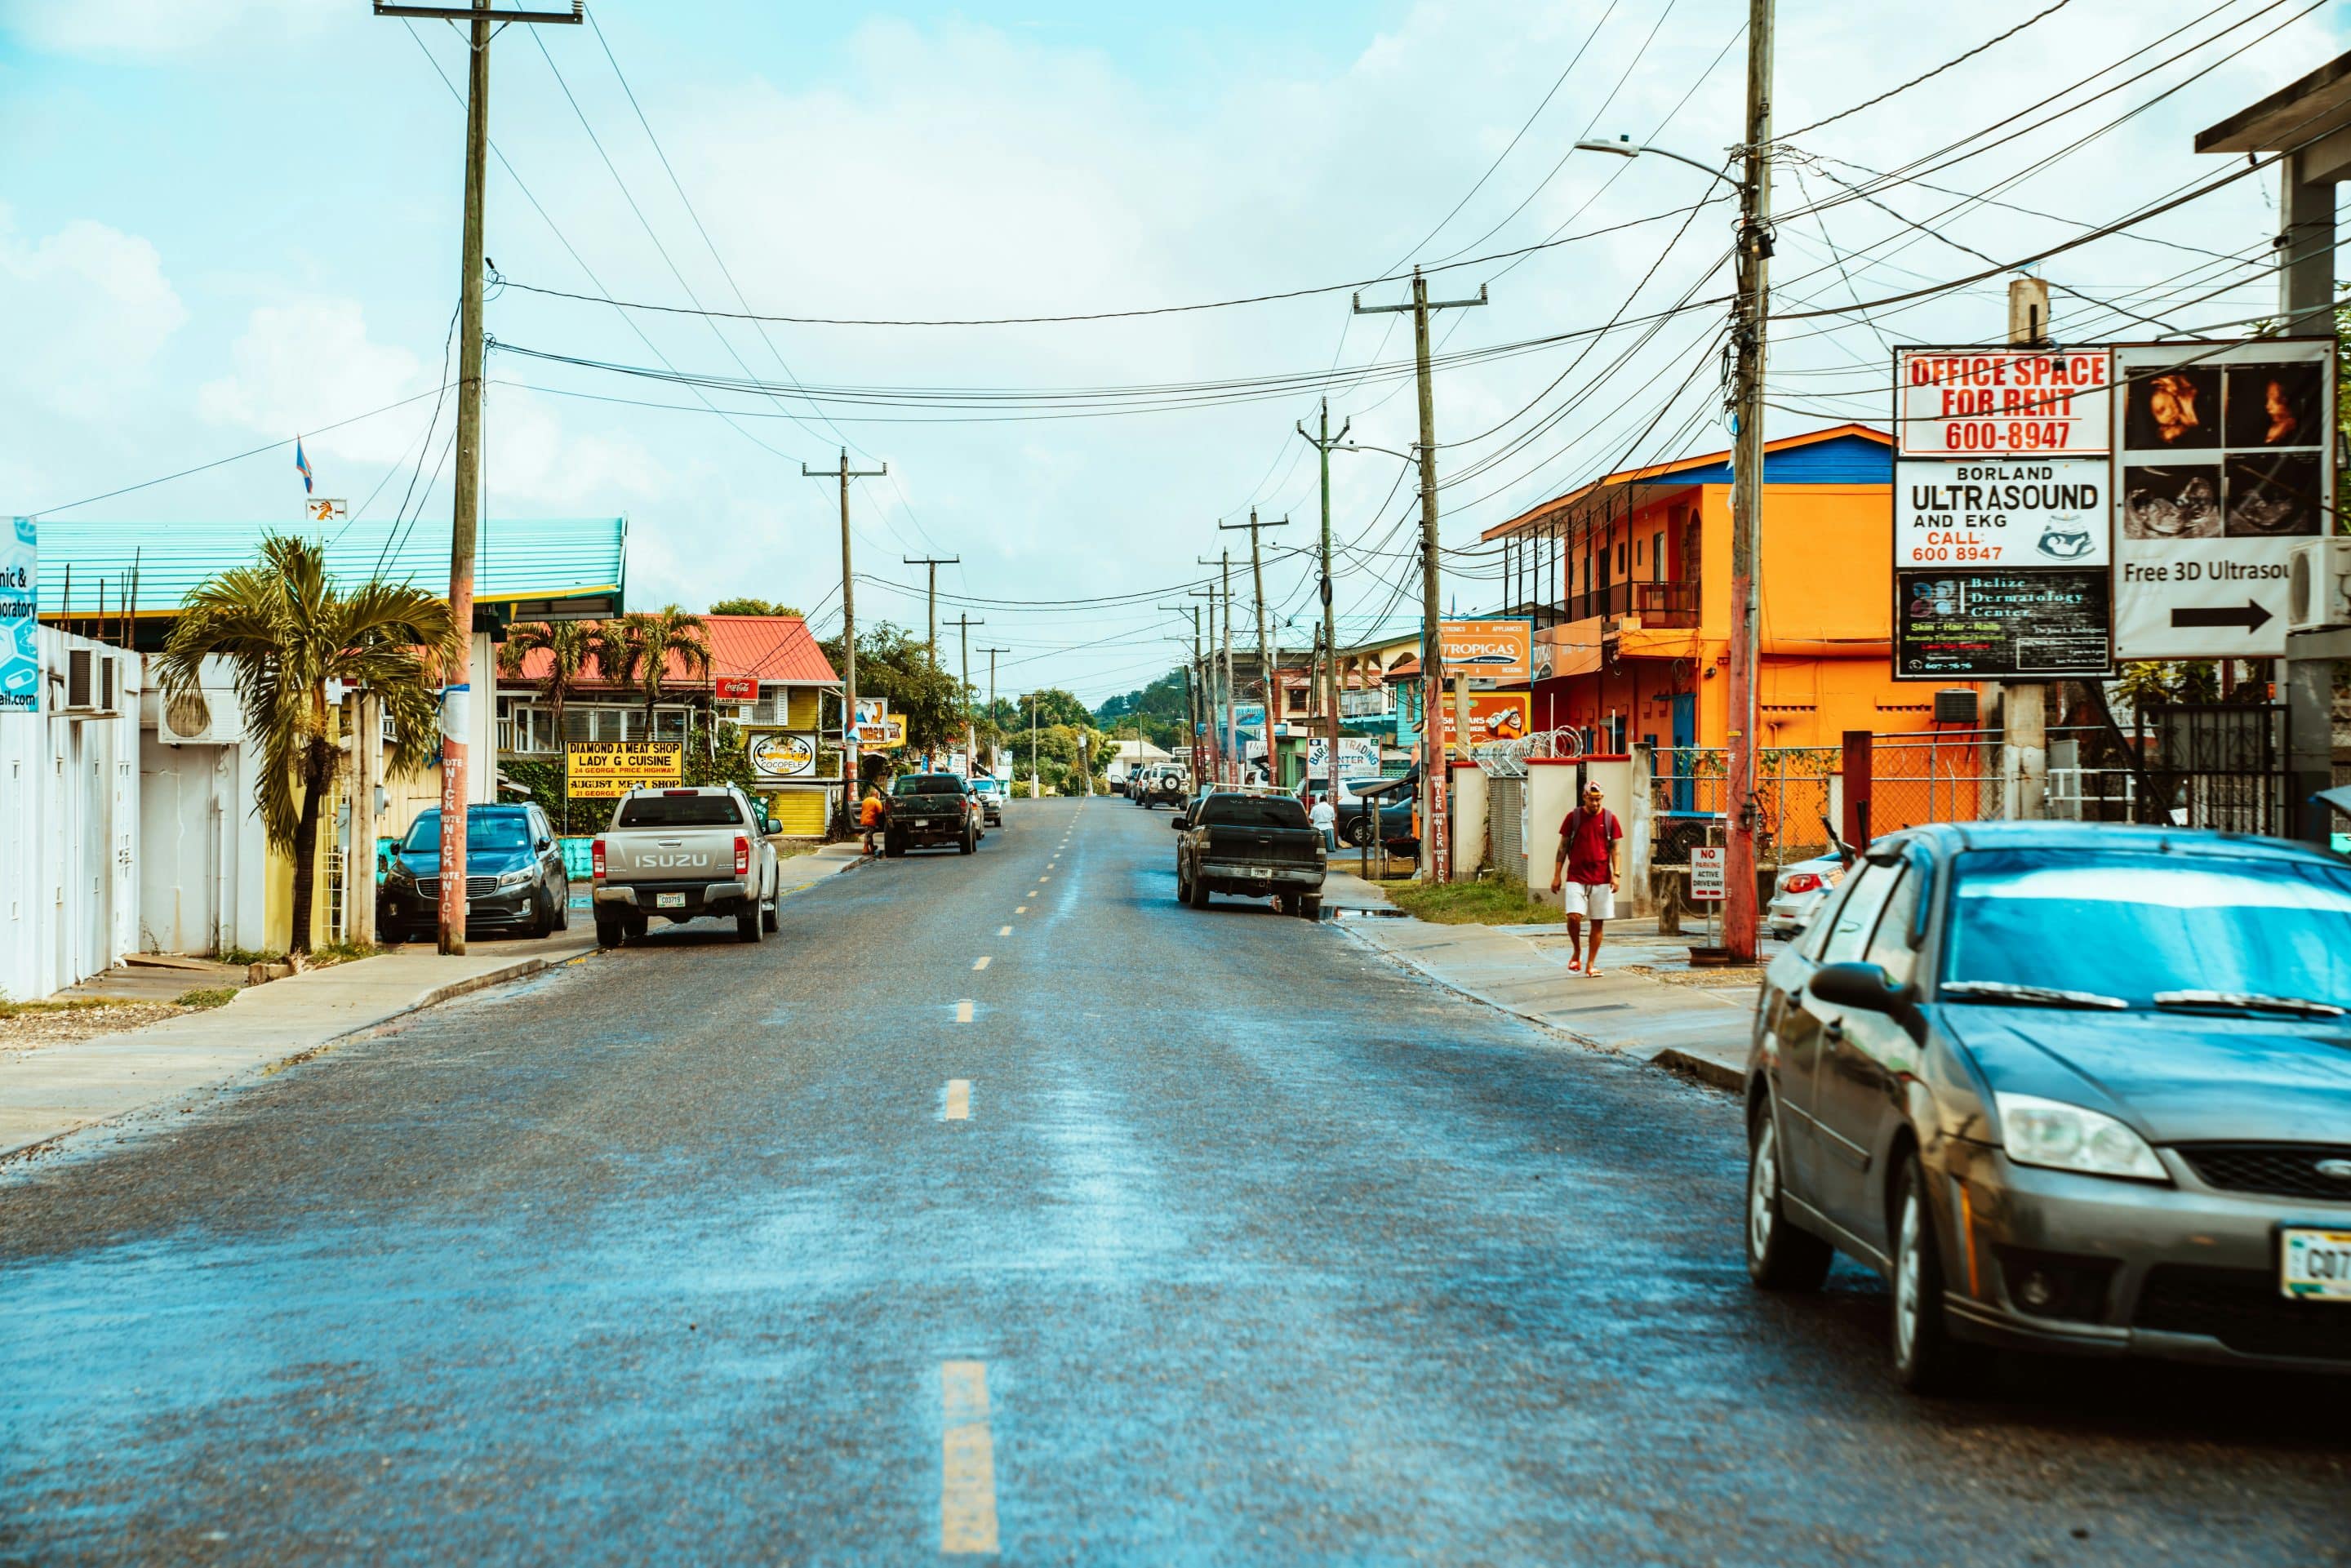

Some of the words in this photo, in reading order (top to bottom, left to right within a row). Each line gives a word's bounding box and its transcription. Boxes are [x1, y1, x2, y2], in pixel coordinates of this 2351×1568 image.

[1912, 358, 2006, 387] OFFICE
[2014, 356, 2104, 386] SPACE
[1941, 389, 1994, 417] FOR
[2002, 388, 2076, 416] RENT
[1946, 422, 2070, 450] 600-8947
[1957, 467, 2053, 481] BORLAND
[1913, 484, 2098, 511] ULTRASOUND
[1913, 515, 1953, 527] AND
[1966, 514, 2007, 527] EKG
[1913, 548, 1948, 561] 600
[1956, 547, 2002, 561] 8947
[18, 567, 27, 588] &
[2125, 563, 2168, 582] Free
[2174, 562, 2202, 580] 3D
[1971, 578, 2026, 588] Belize
[1971, 590, 2083, 604] Dermatology
[1911, 623, 1935, 631] Skin
[1943, 623, 1965, 631] Hair
[1974, 622, 2001, 631] Nails
[1441, 643, 1516, 655] TROPIGAS
[570, 743, 614, 753] DIAMOND
[616, 743, 623, 753] A
[625, 743, 651, 753] MEAT
[653, 743, 680, 753] SHOP
[1344, 739, 1380, 766] TRADING
[579, 756, 607, 766] LADY
[614, 756, 621, 766] G
[628, 756, 671, 766] CUISINE
[1324, 755, 1364, 764] CNTER
[444, 767, 456, 811] NICK
[571, 780, 612, 788] AUGUST
[651, 780, 679, 788] SHOP
[1434, 781, 1442, 810] NICK
[1434, 819, 1443, 847] NICK
[443, 824, 454, 867] NICK
[1700, 849, 1715, 859] NO
[635, 854, 708, 868] ISUZU
[1437, 855, 1445, 884] NICK
[442, 881, 452, 924] NICK
